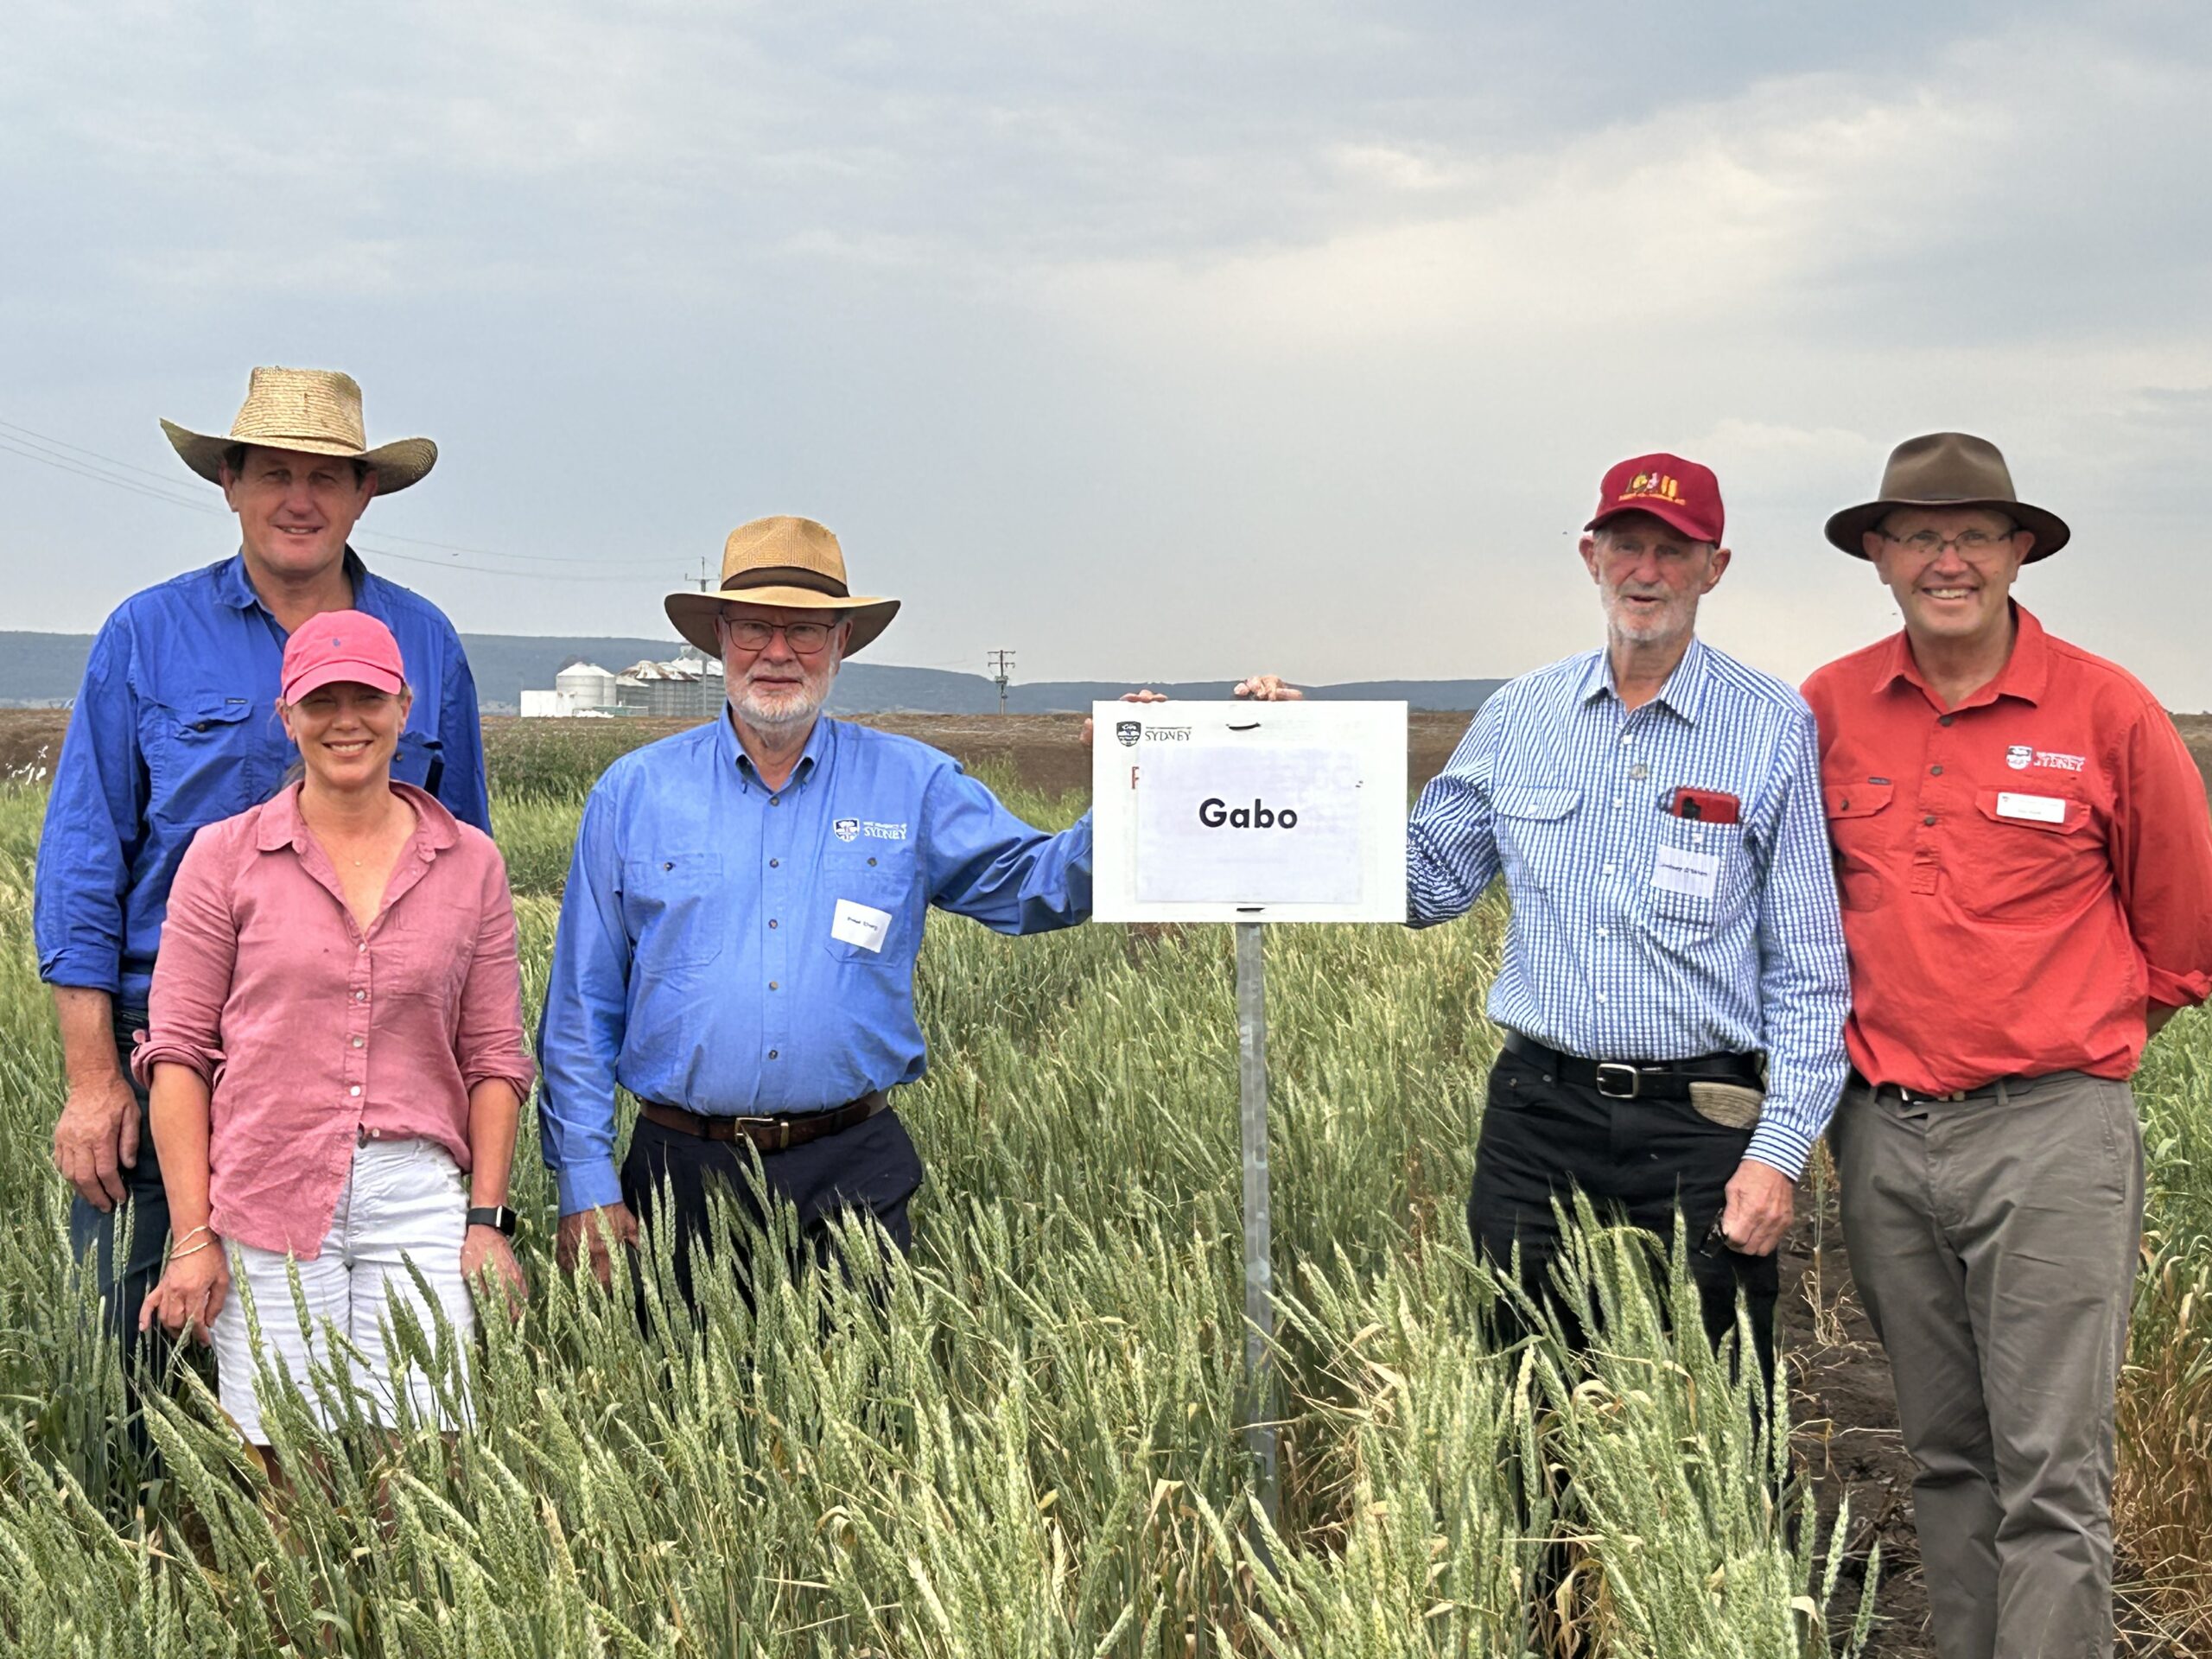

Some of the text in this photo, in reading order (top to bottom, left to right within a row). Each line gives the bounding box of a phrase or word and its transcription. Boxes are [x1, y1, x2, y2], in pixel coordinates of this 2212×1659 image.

[1145, 730, 1192, 741] SYDNEY
[1198, 798, 1298, 829] Gabo
[864, 826, 906, 840] SYDNEY
